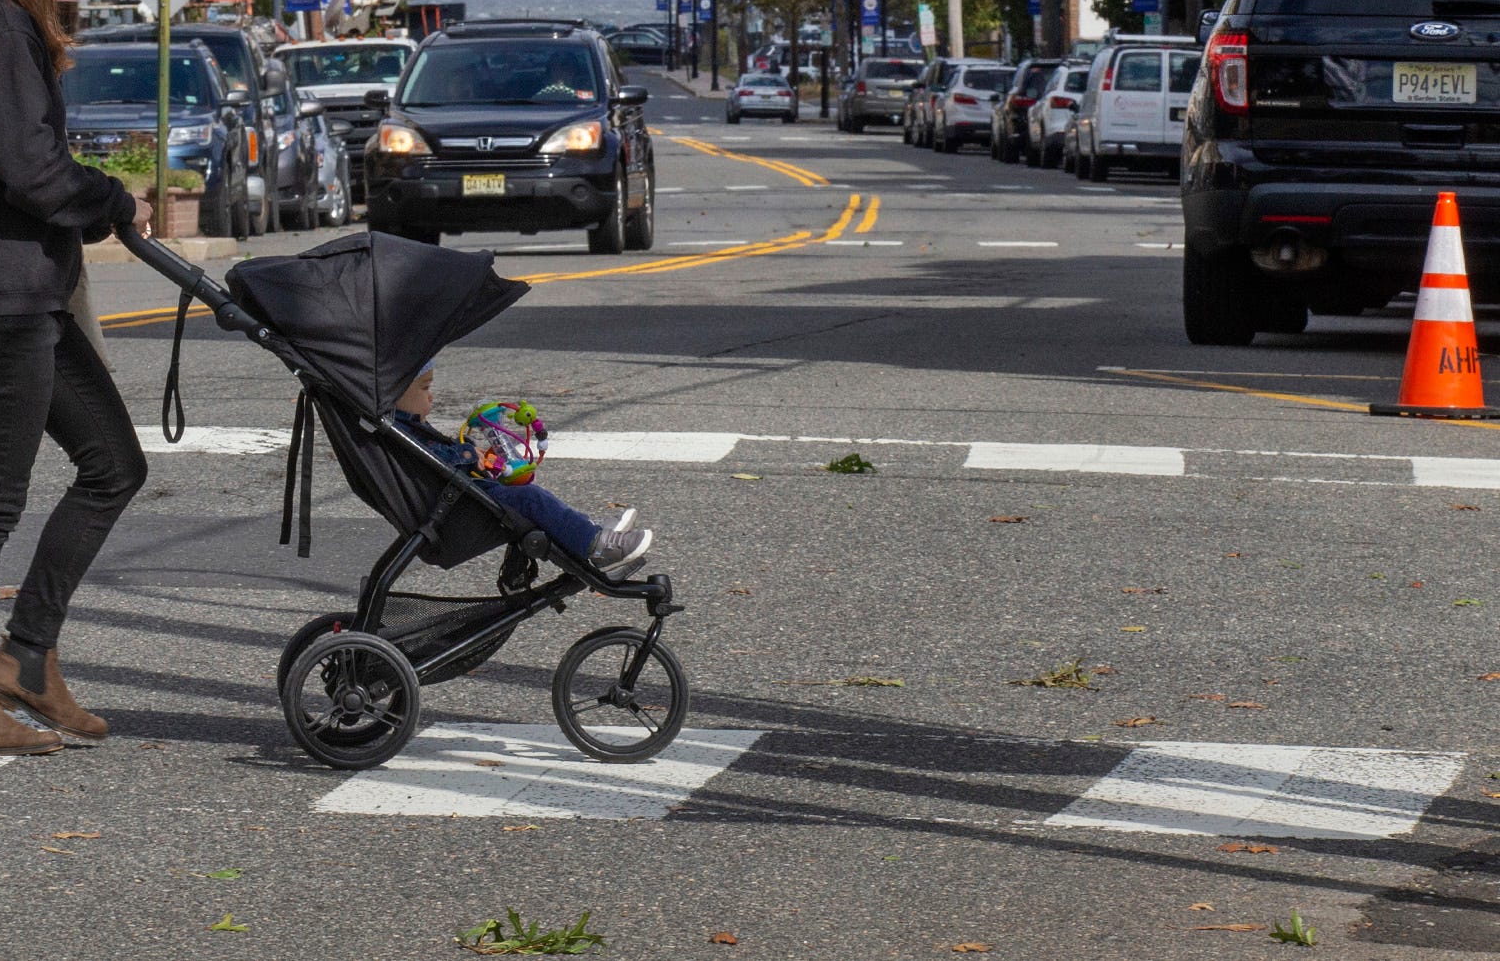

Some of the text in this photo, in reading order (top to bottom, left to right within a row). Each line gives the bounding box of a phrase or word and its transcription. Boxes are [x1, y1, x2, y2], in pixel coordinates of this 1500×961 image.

[1421, 24, 1449, 35] Ford
[1399, 73, 1470, 95] P94 EVL
